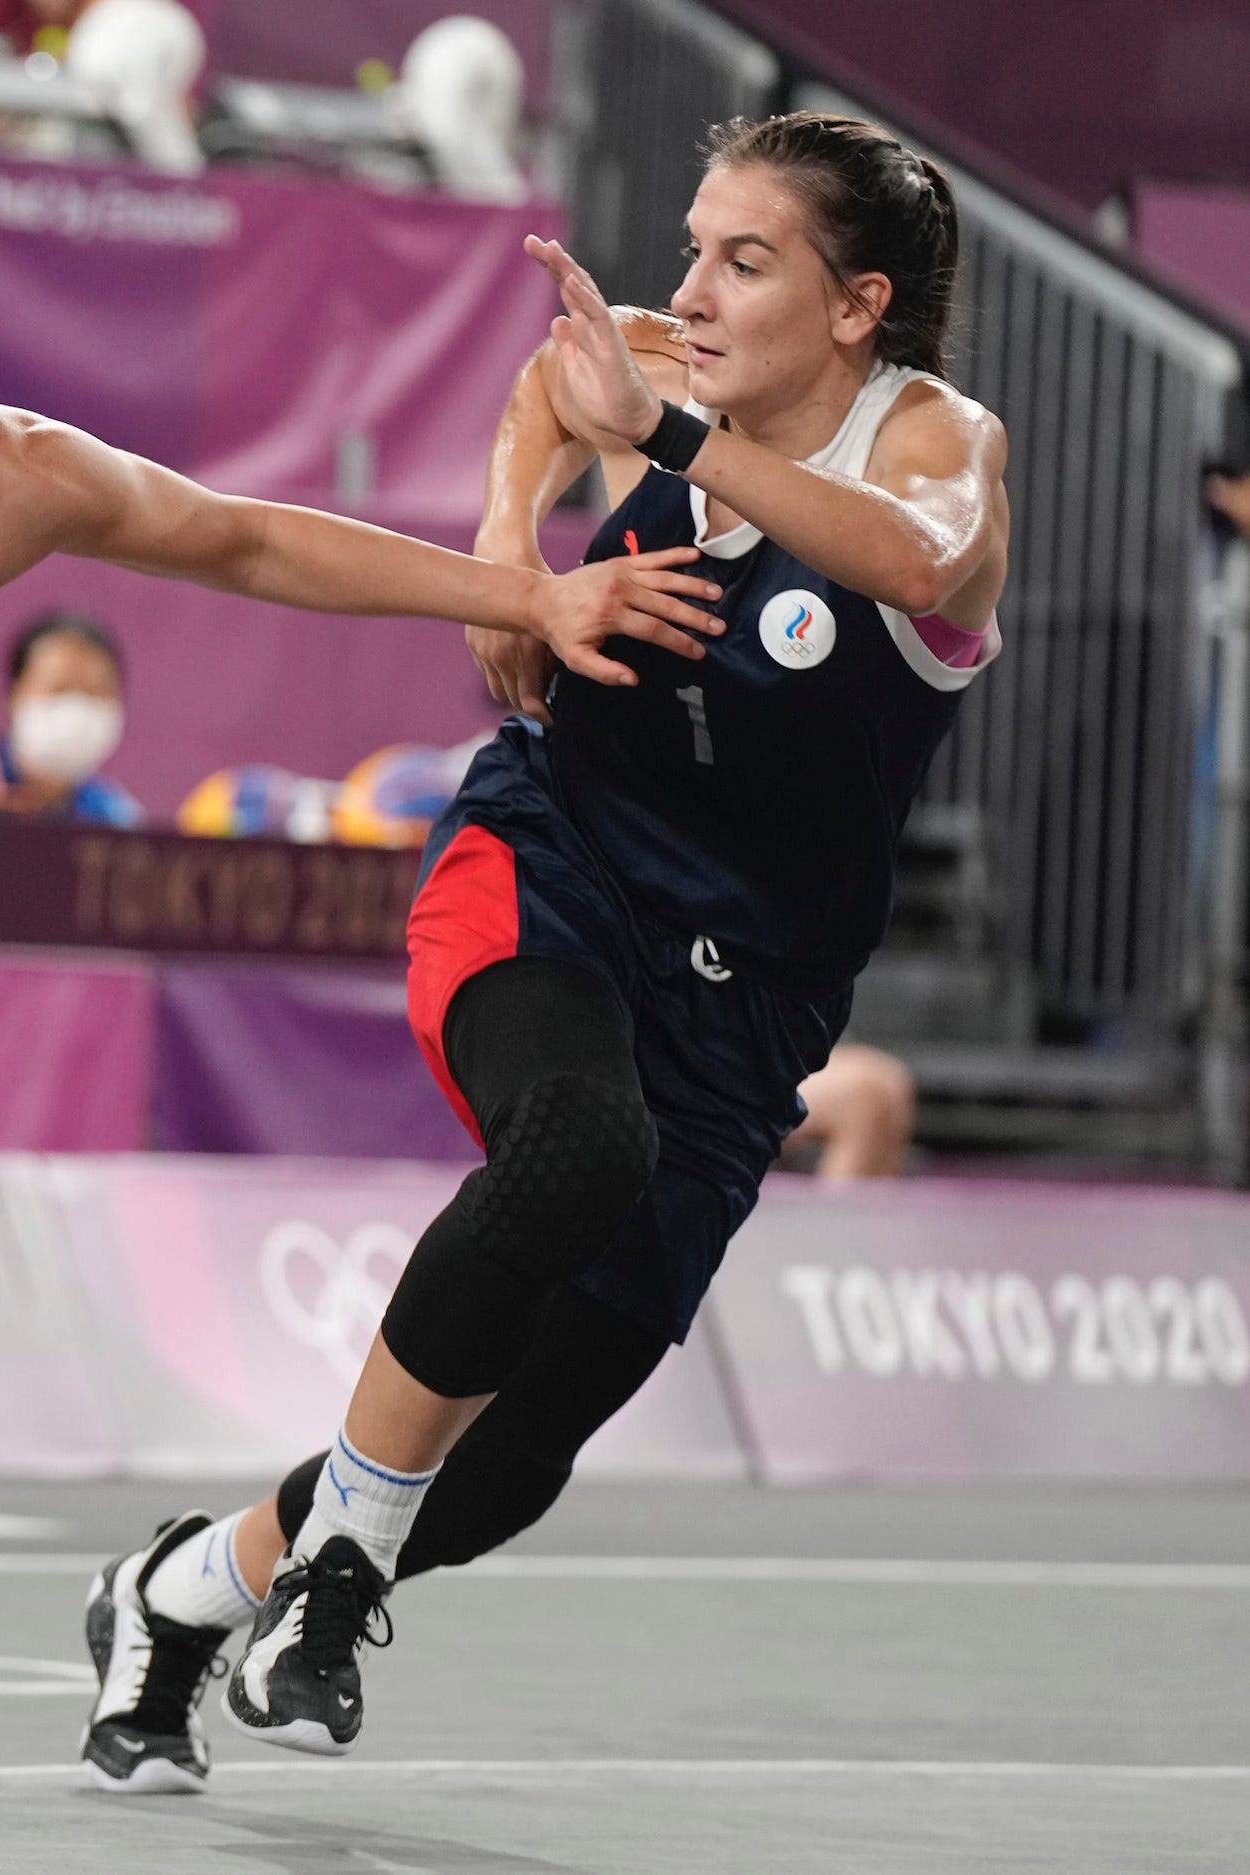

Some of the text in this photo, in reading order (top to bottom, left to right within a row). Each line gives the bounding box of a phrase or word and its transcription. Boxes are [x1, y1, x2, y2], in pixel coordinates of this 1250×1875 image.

[675, 684, 715, 766] 1
[77, 836, 293, 944] TOKYO
[781, 1264, 1250, 1387] TOKYO 2020
